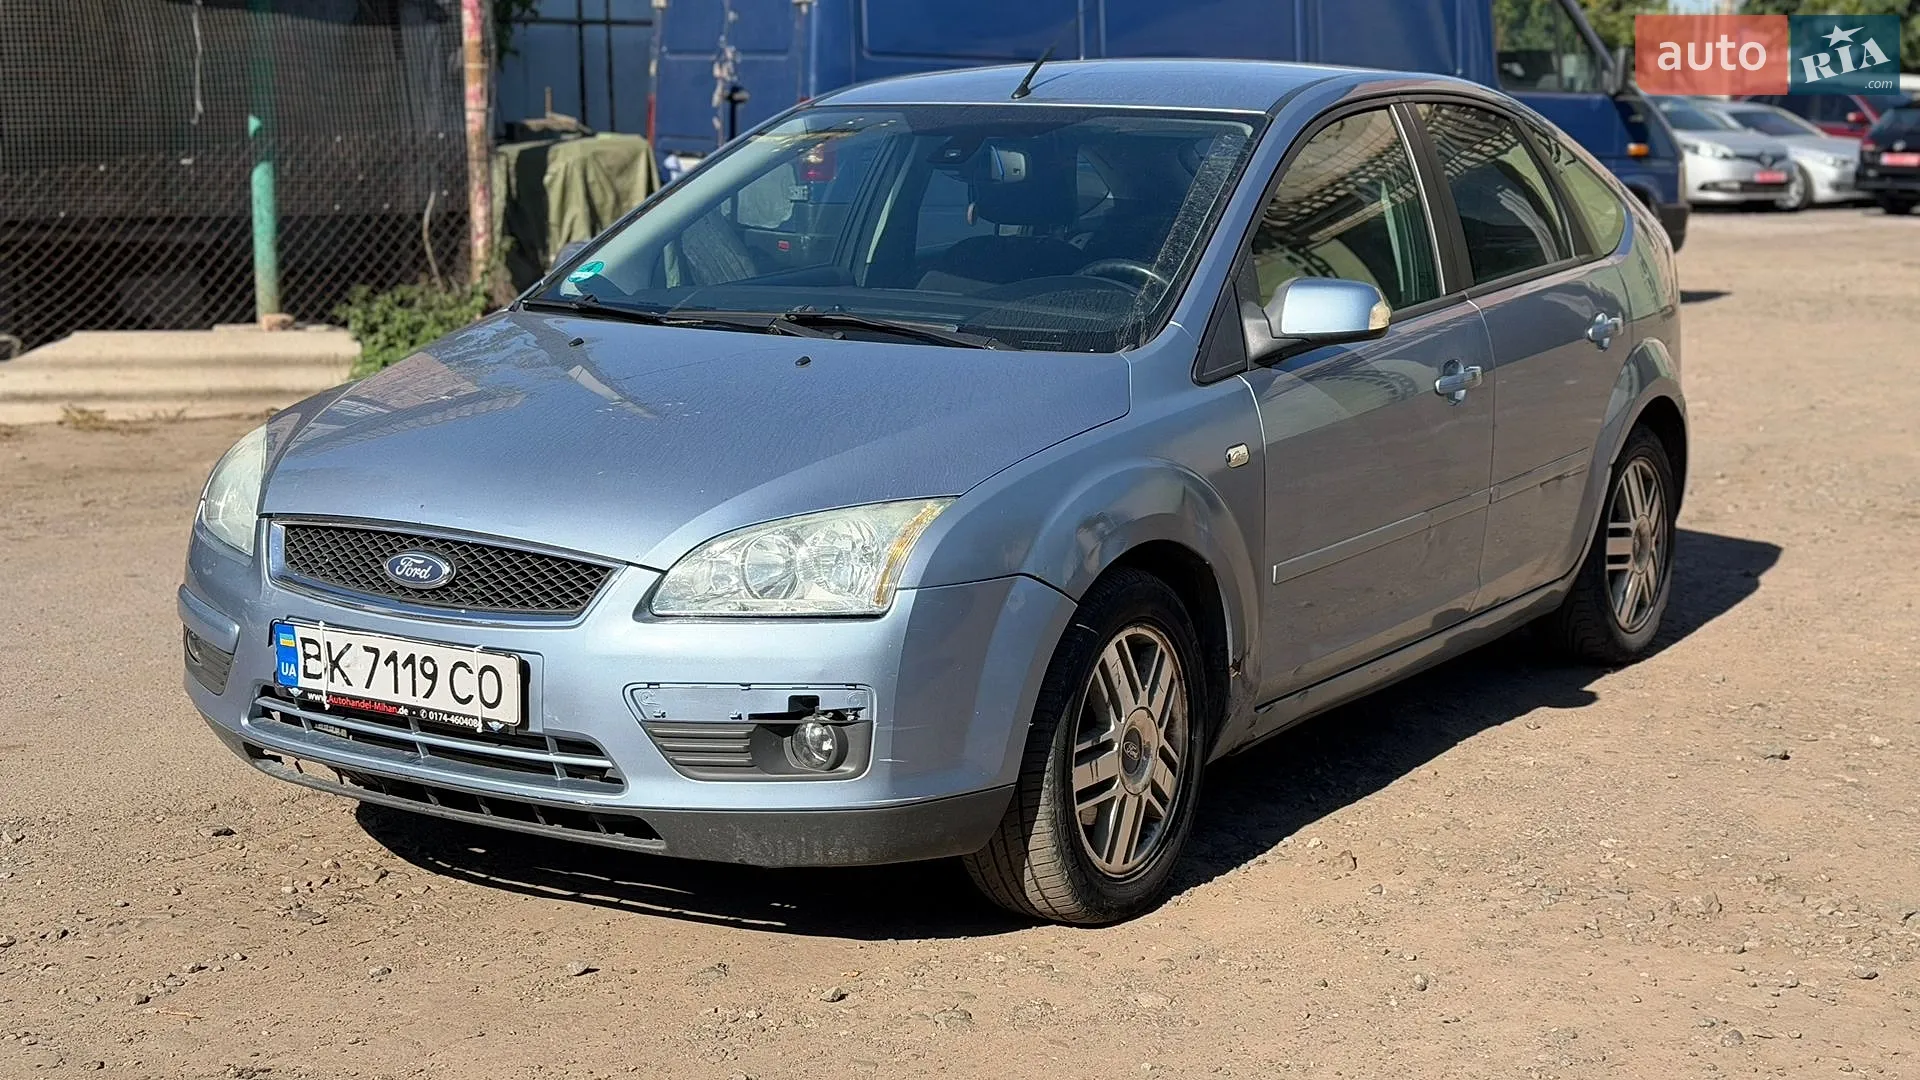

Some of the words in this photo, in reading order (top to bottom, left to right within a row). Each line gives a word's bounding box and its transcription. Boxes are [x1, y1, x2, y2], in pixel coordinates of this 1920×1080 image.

[395, 557, 433, 579] Ford
[281, 662, 297, 678] UA
[300, 637, 353, 687] BK
[363, 646, 439, 699] 7119
[449, 661, 503, 709] CO
[428, 711, 482, 729] 0174-460408
